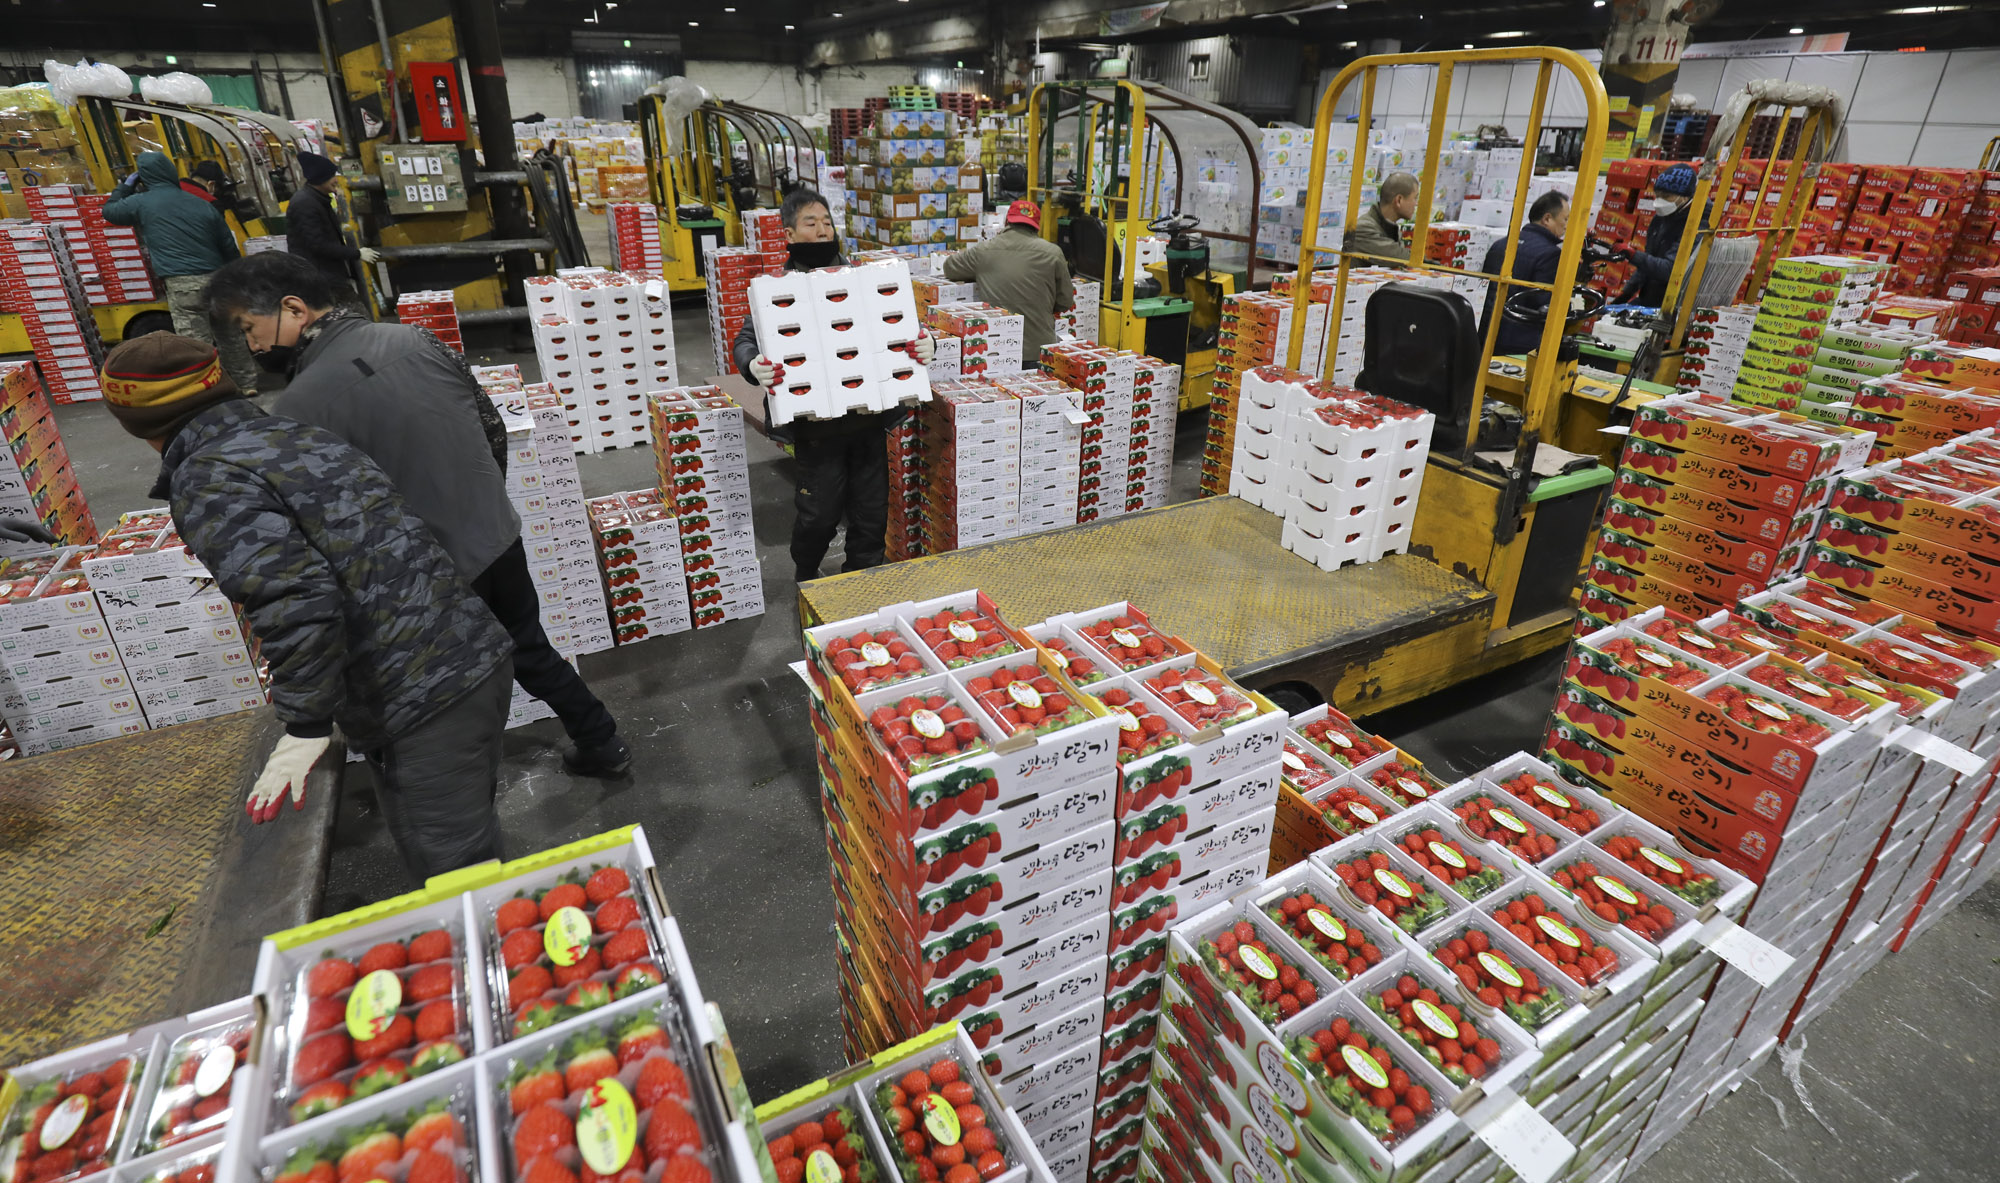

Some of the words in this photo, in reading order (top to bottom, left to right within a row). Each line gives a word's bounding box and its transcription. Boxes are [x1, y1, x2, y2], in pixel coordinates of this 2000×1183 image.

[1636, 37, 1655, 60] 11
[1663, 38, 1678, 60] 11
[1671, 168, 1693, 176] THE
[1119, 228, 1126, 240] 9
[1909, 399, 1942, 413] 고맛나루
[1944, 405, 1981, 422] 딸기
[1691, 426, 1727, 444] 고맛나루
[1730, 433, 1771, 457] 딸기
[1899, 425, 1931, 439] 고맛나루
[1680, 460, 1716, 478] 고맛나루
[1718, 468, 1758, 492] 딸기
[1670, 492, 1704, 510] 고맛나루
[1706, 500, 1745, 525] 딸기
[1908, 508, 1955, 529] 고맛나루
[1659, 523, 1693, 542] 고맛나루
[1695, 532, 1733, 557] 딸기
[1650, 553, 1684, 573] 고맛나루
[1685, 563, 1722, 588] 딸기
[1892, 543, 1937, 564] 고맛나루
[1941, 555, 1992, 583] 딸기
[1640, 582, 1672, 601] 고맛나루
[1674, 593, 1709, 618] 딸기
[1878, 576, 1923, 597] 고맛나루
[1926, 589, 1976, 618] 딸기
[1643, 689, 1692, 719] 고맛나루
[1695, 710, 1749, 750] 딸기
[1016, 752, 1060, 778] 고맛나루
[1063, 738, 1109, 763] 딸기
[1206, 743, 1241, 766] 고맛나루
[1244, 732, 1280, 753] 딸기
[1630, 727, 1677, 759] 고맛나루
[1680, 750, 1733, 790] 딸기
[1018, 804, 1060, 830] 고맛나루
[1063, 789, 1107, 815] 딸기
[1201, 790, 1236, 812] 고맛나루
[1238, 778, 1274, 801] 딸기
[1618, 766, 1664, 797] 고맛나루
[1667, 788, 1719, 830] 딸기
[1196, 836, 1228, 858] 고맛나루
[1231, 823, 1266, 846] 딸기
[1020, 854, 1060, 879] 고맛나루
[1063, 838, 1106, 863] 딸기
[1191, 879, 1224, 900] 고맛나루
[1226, 865, 1261, 886] 딸기
[1019, 900, 1059, 926] 고맛나루
[1061, 884, 1103, 909] 딸기
[1018, 946, 1057, 971] 고맛나루
[1060, 929, 1101, 952] 딸기
[1018, 990, 1056, 1014] 고맛나루
[1058, 972, 1099, 995] 딸기
[1173, 968, 1185, 985] 2kg
[1017, 1031, 1054, 1055] 고맛나루
[1056, 1013, 1096, 1036] 딸기
[1167, 1008, 1178, 1025] 2kg
[1016, 1071, 1050, 1094] 고맛나루
[1054, 1053, 1092, 1075] 딸기
[1022, 1107, 1048, 1126] 맛나루
[1052, 1088, 1089, 1110] 딸기
[1049, 1121, 1085, 1142] 딸기
[1048, 1154, 1082, 1176] 딸기
